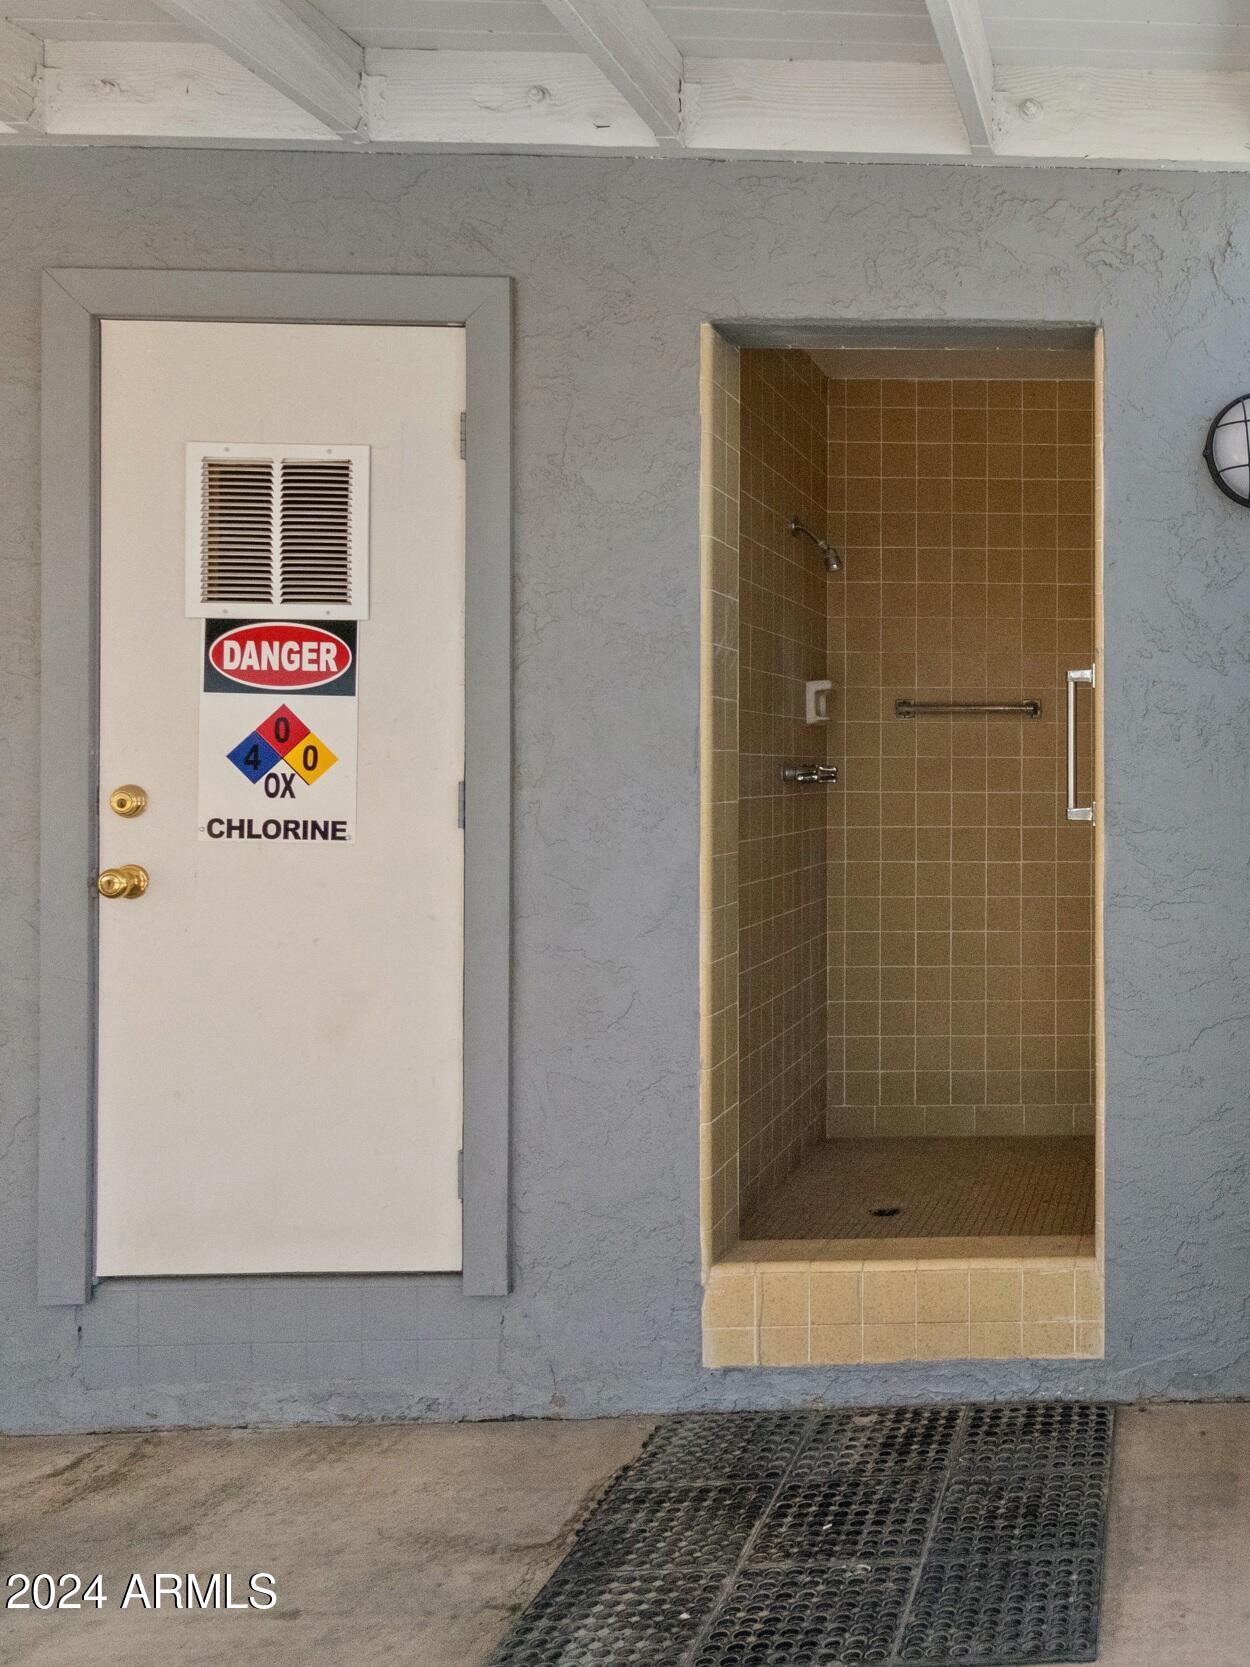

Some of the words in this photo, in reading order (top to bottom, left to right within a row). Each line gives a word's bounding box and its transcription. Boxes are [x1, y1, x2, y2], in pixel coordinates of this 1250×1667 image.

[223, 640, 338, 672] DANGER
[274, 717, 290, 743] 0
[244, 744, 261, 770] 4
[303, 745, 318, 771] 0
[264, 773, 296, 799] OX
[207, 818, 348, 841] CHLORINE
